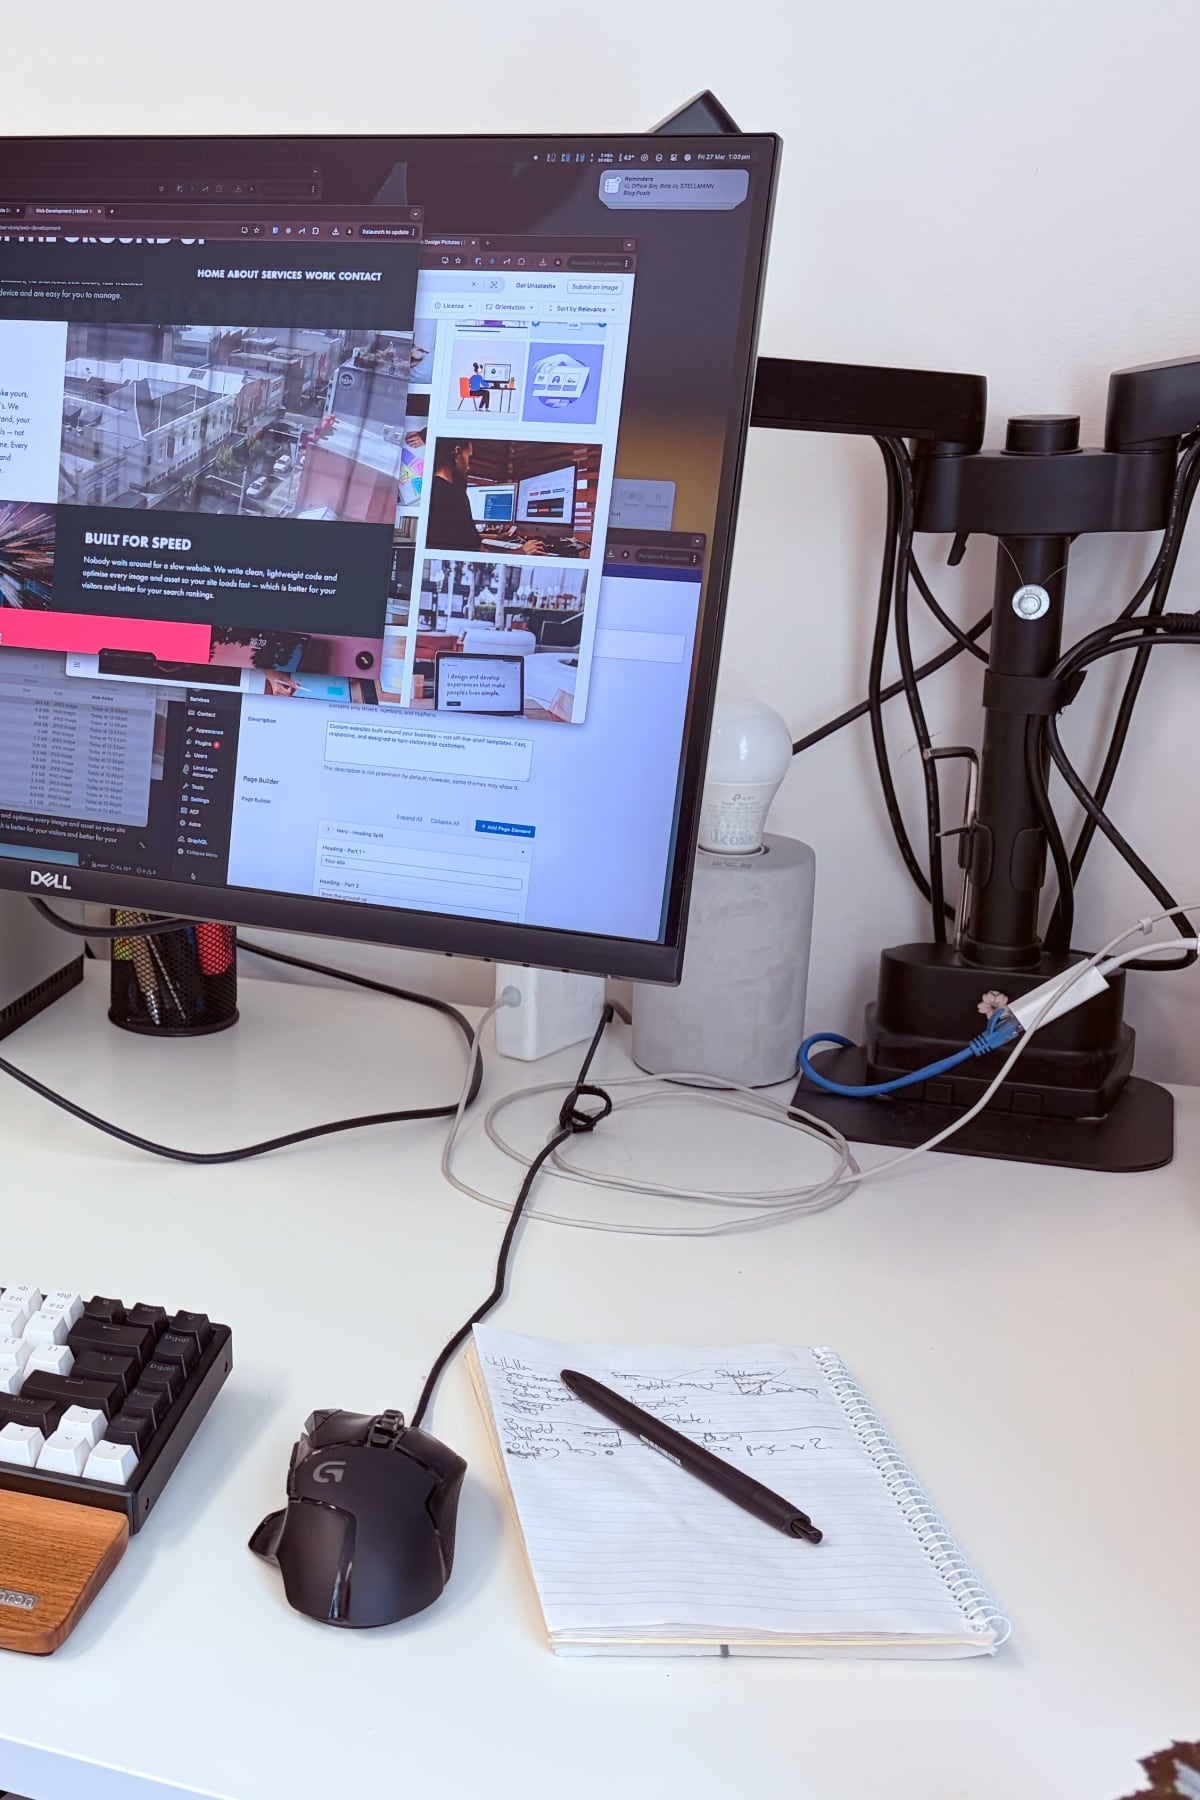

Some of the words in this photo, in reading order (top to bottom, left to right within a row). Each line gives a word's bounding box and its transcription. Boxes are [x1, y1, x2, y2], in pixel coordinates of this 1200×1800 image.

[197, 269, 225, 278] HOME
[227, 270, 259, 279] ABOUT
[261, 270, 302, 280] SERVICES
[305, 271, 336, 280] WORK
[338, 272, 382, 281] CONTACT
[20, 289, 33, 297] and
[62, 289, 71, 298] for
[94, 293, 122, 301] manage.
[11, 441, 28, 451] Every
[85, 532, 120, 546] BUILT
[122, 534, 149, 548] FOR
[152, 537, 192, 551] SPEED
[84, 556, 111, 567] Nobody
[129, 560, 152, 568] around
[153, 560, 163, 569] for
[170, 562, 185, 570] slow
[186, 564, 212, 573] website.
[214, 565, 226, 574] We
[245, 567, 265, 578] clean,
[267, 568, 304, 581] lightweight
[305, 572, 322, 580] code
[323, 573, 338, 582] and
[82, 570, 109, 578] optimise
[109, 573, 128, 581] every
[128, 573, 149, 583] image
[150, 574, 163, 582] and
[219, 578, 238, 588] loads
[238, 579, 251, 588] fast
[260, 581, 280, 591] which
[288, 583, 308, 593] better
[309, 585, 319, 594] for
[82, 582, 103, 590] visitors
[117, 584, 136, 593] better
[137, 585, 146, 593] for
[163, 588, 185, 596] search
[186, 589, 215, 601] rankings.
[243, 776, 258, 784] Page
[79, 832, 95, 840] better
[30, 871, 71, 890] DELL
